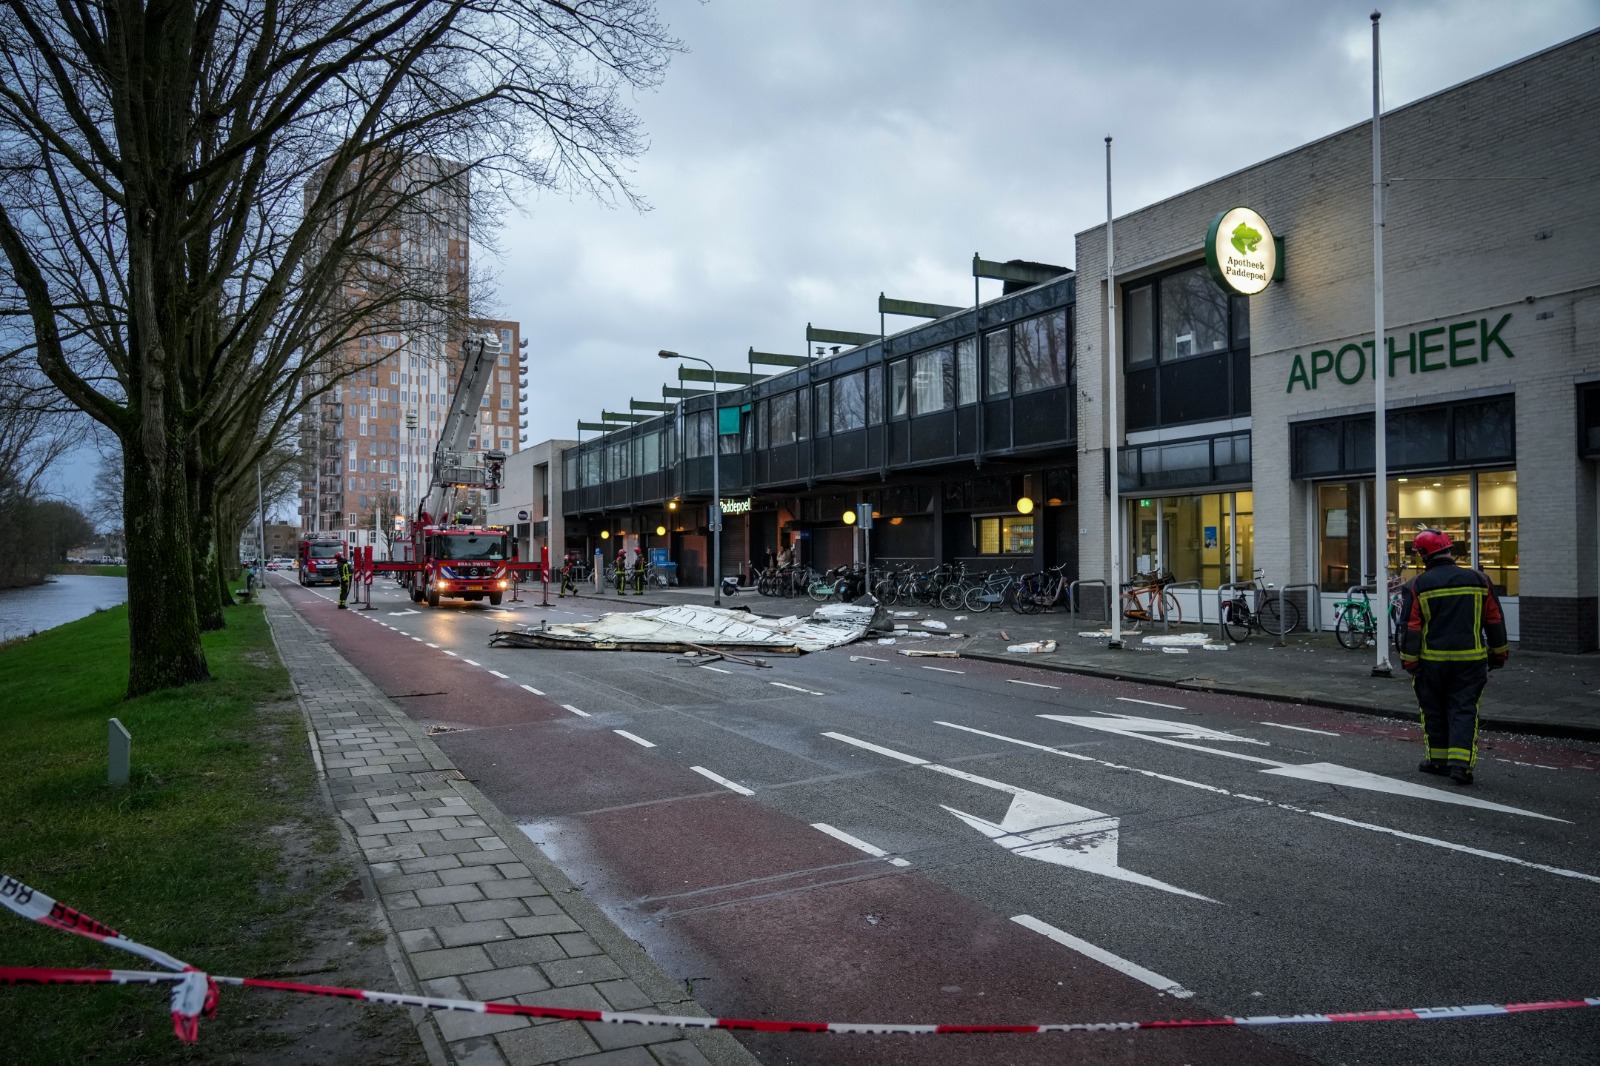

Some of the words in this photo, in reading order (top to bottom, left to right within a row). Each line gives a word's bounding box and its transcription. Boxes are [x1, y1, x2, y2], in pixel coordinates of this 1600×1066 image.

[1227, 256, 1265, 270] Apotheek
[1226, 266, 1266, 281] Paddepoel
[1286, 313, 1515, 393] APOTHEEK
